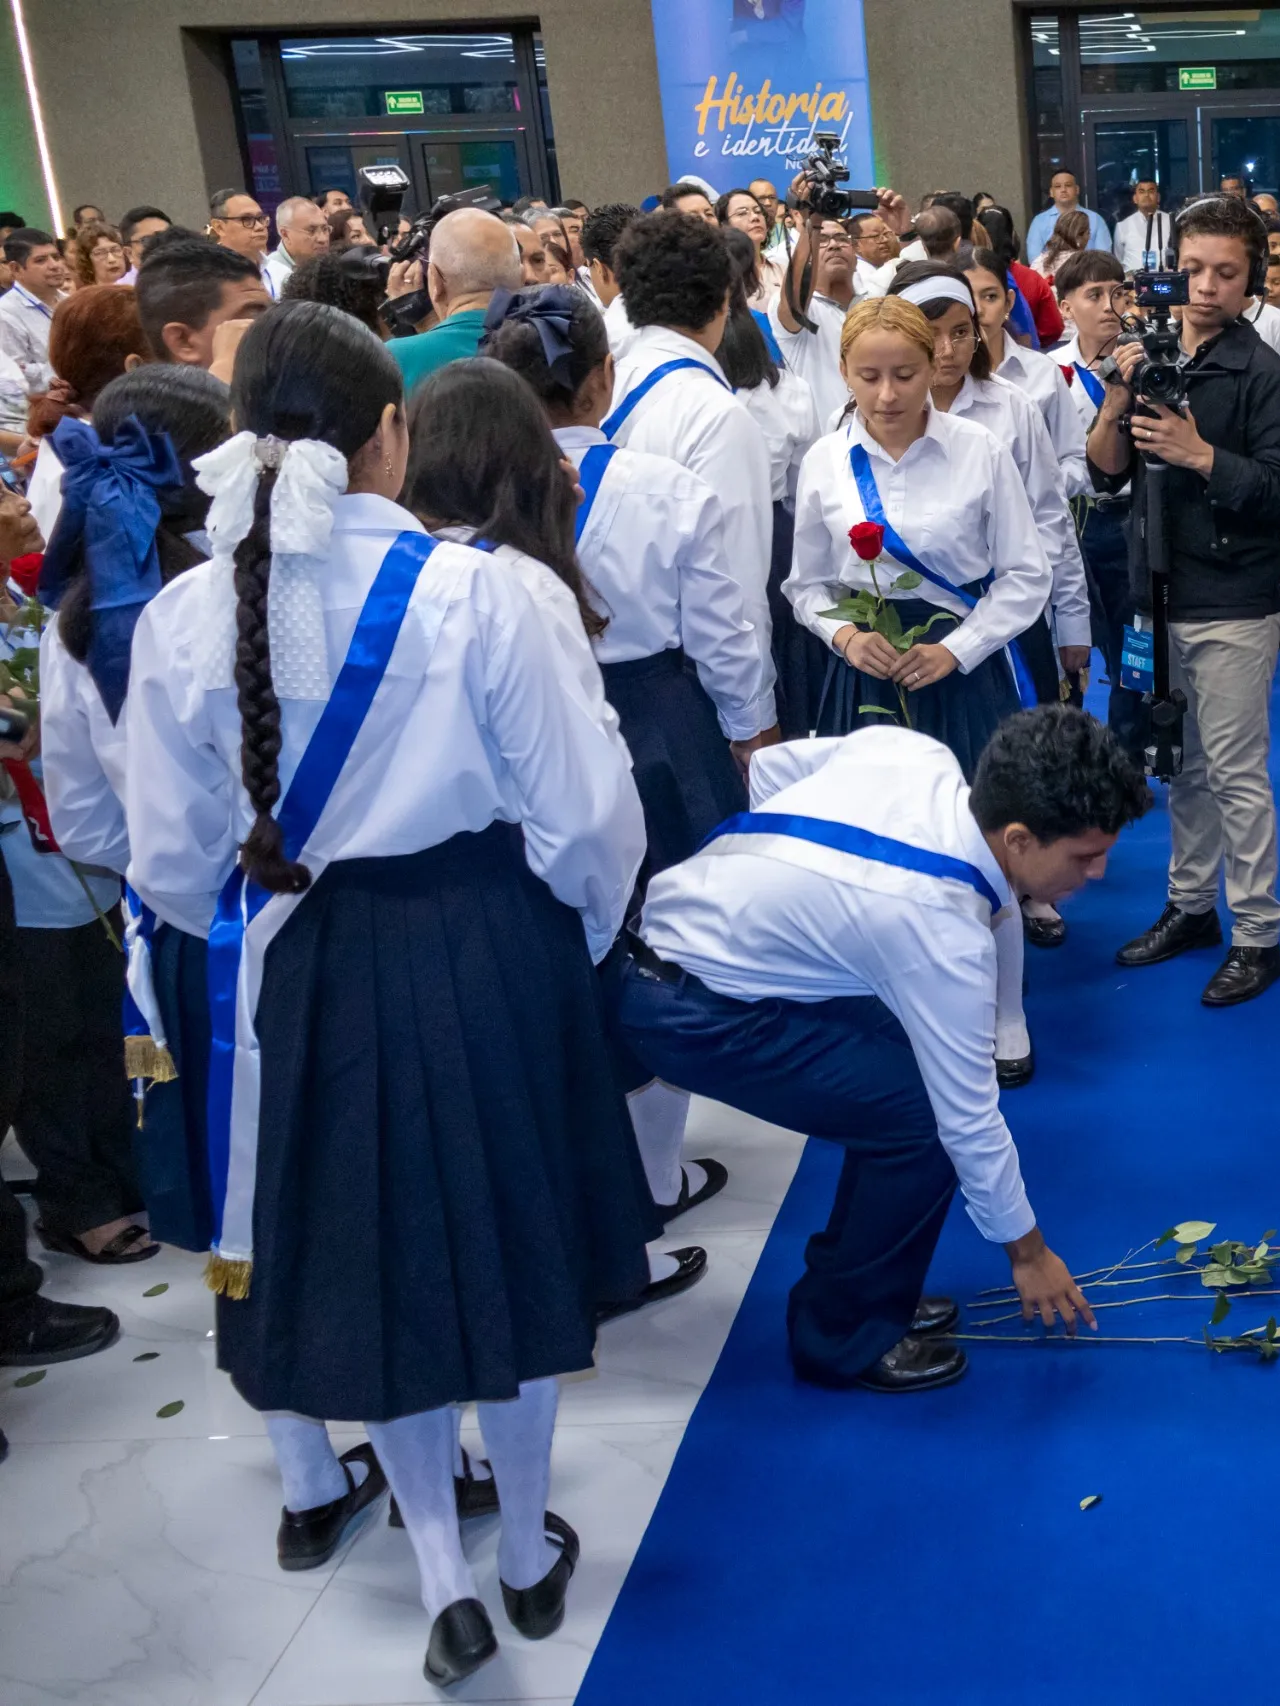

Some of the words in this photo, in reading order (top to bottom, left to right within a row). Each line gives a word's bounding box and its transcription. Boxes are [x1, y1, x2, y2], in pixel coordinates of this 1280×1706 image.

[695, 72, 849, 135] Historia
[694, 140, 709, 157] e
[721, 111, 854, 157] identidd
[1128, 653, 1146, 669] STAFF
